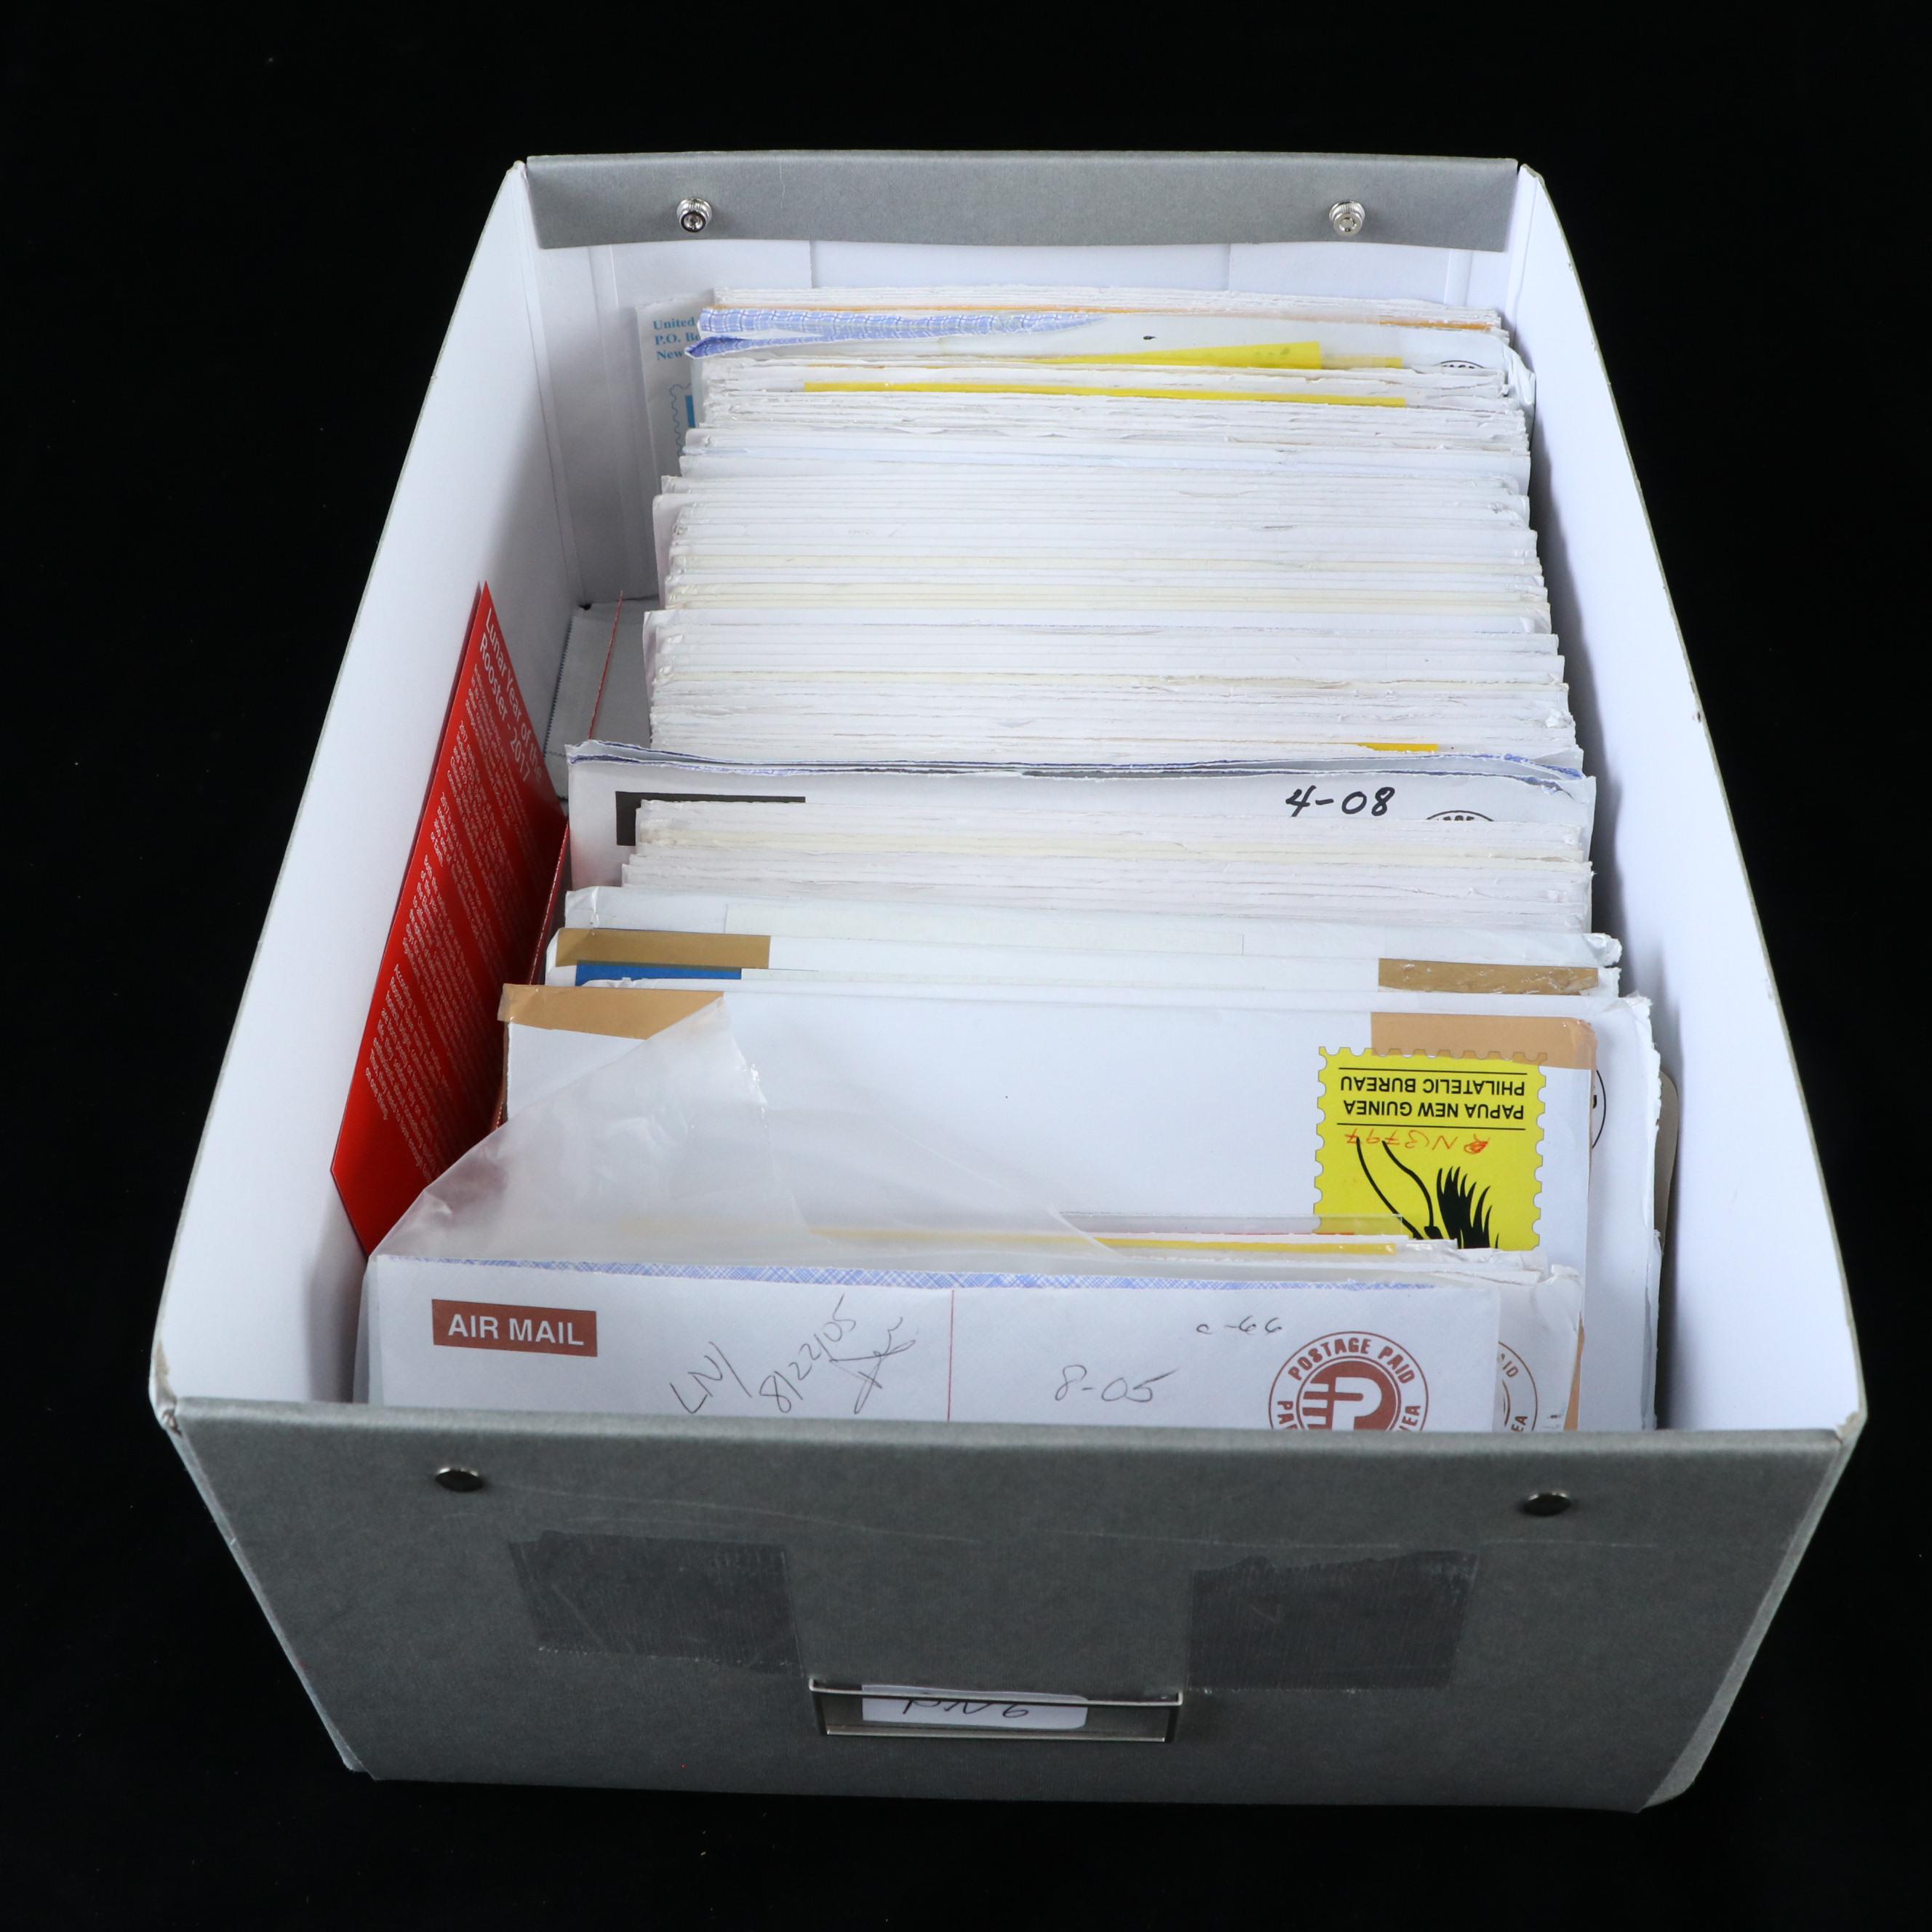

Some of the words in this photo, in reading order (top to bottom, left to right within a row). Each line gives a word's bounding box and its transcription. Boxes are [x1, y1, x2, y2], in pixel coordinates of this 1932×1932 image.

[652, 316, 695, 330] United
[655, 334, 681, 346] P.O.
[656, 349, 685, 361] New
[485, 607, 508, 677] Lunar
[507, 674, 522, 722] Year
[521, 724, 532, 747] of
[530, 744, 543, 783] the
[479, 632, 508, 720] Rooster
[510, 730, 530, 783] 2017
[1285, 785, 1395, 818] 4-08
[1341, 1075, 1416, 1093] BUREAU
[1423, 1077, 1525, 1097] PHILATELIC
[1343, 1099, 1413, 1117] GUINEA
[1417, 1101, 1458, 1117] NEW
[1465, 1103, 1523, 1119] PAPUA
[447, 1314, 499, 1341] AIR
[509, 1318, 584, 1346] MAIL
[1288, 1338, 1372, 1381] POSTAGE
[1378, 1346, 1415, 1385] PAID
